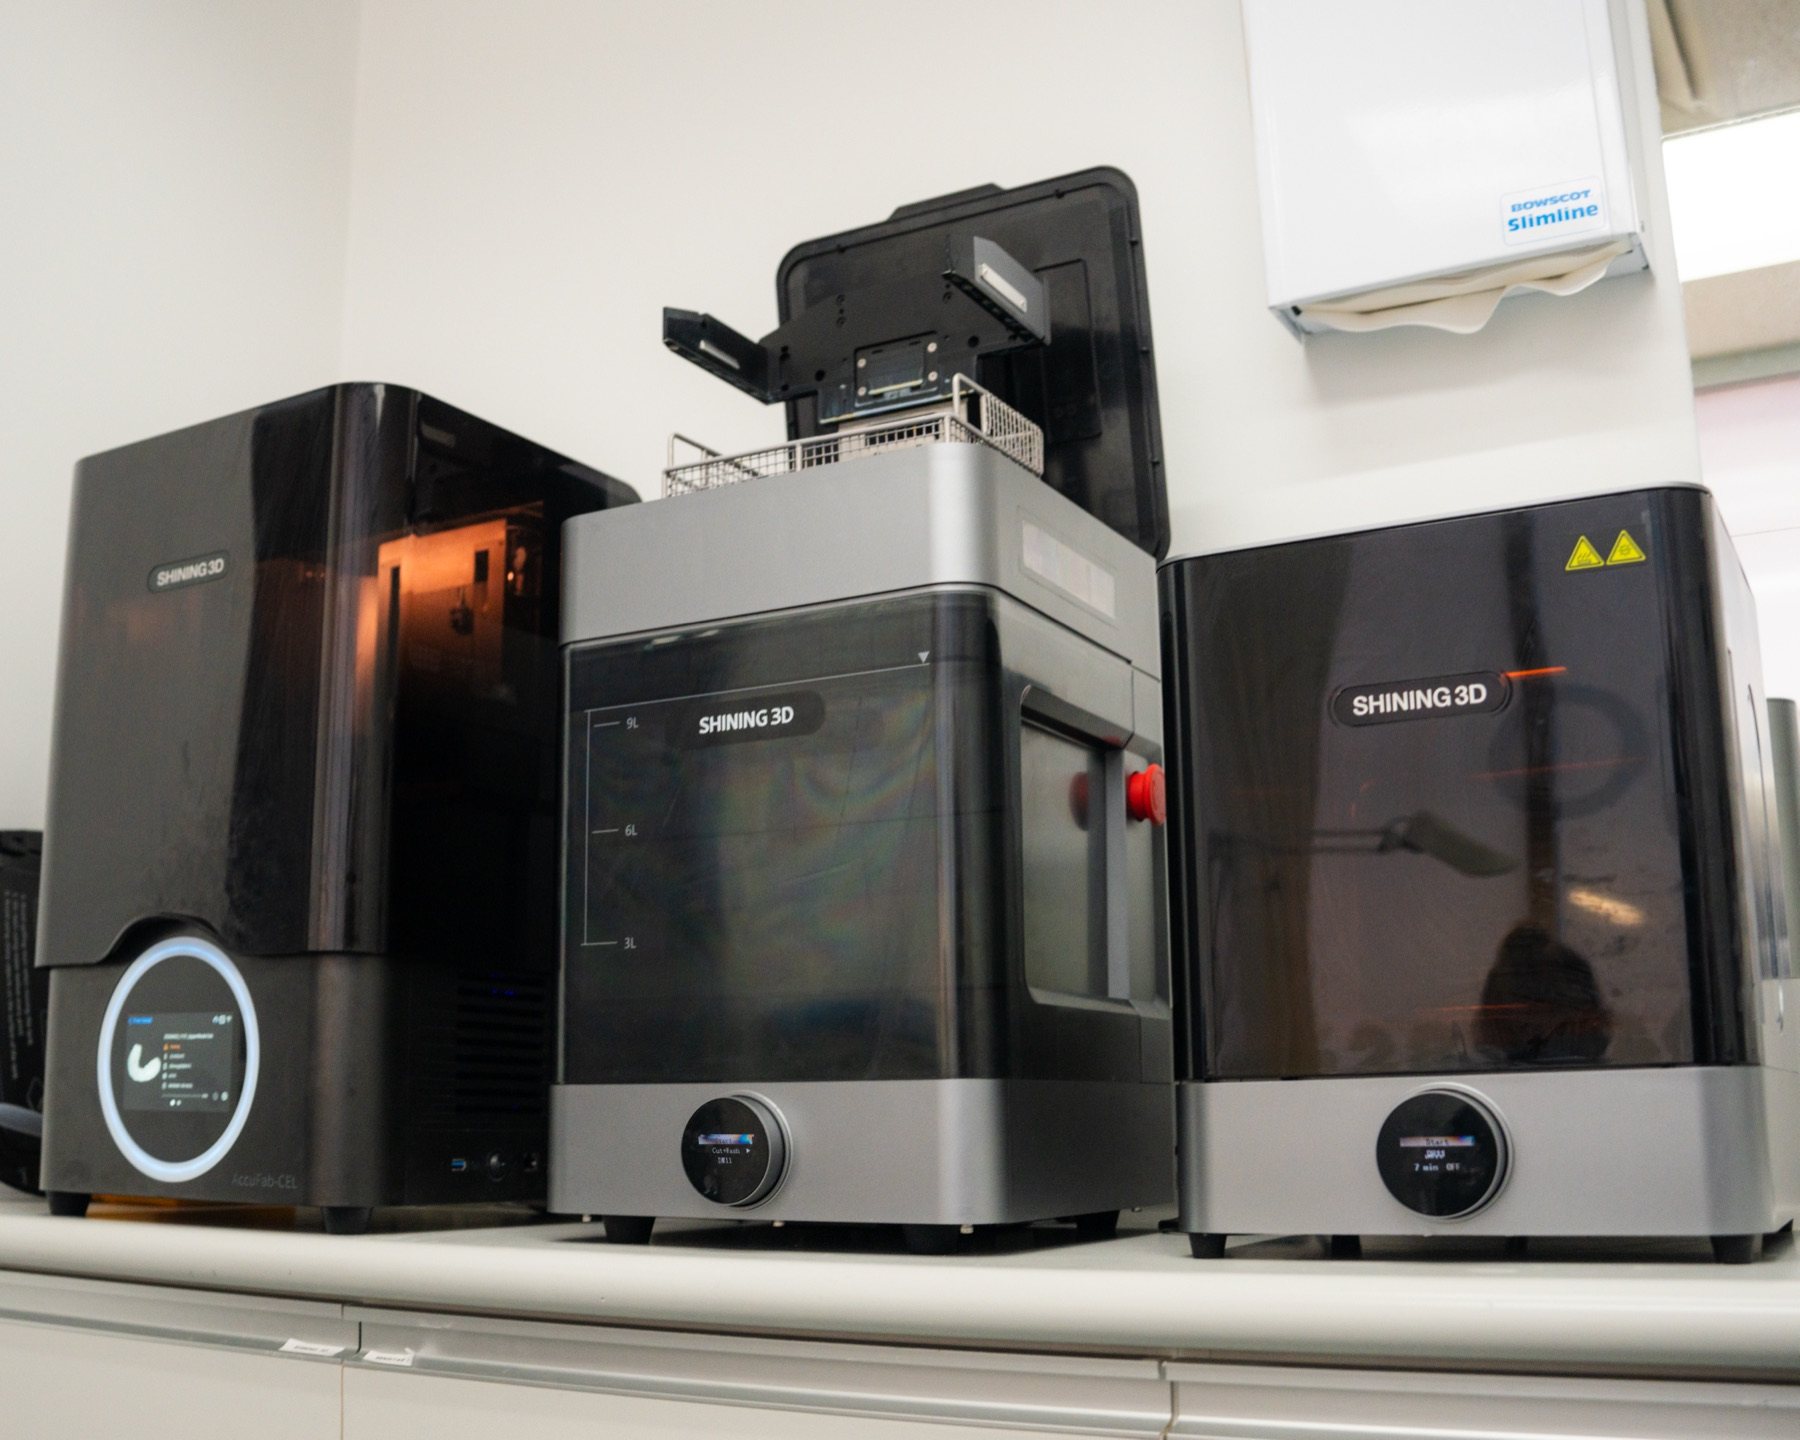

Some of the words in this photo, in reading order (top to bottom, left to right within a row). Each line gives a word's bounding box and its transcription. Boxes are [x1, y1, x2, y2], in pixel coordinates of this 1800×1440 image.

[1511, 189, 1591, 212] BOWSCOT
[1507, 204, 1599, 232] Slimline
[157, 562, 207, 586] SHINING
[207, 558, 225, 576] 3D
[1352, 686, 1450, 716] SHINING
[1454, 683, 1488, 706] 3D
[626, 717, 639, 730] 9L
[699, 709, 768, 735] SHINING
[770, 706, 794, 726] 3D
[625, 824, 638, 837] 6L
[624, 937, 637, 950] 3L
